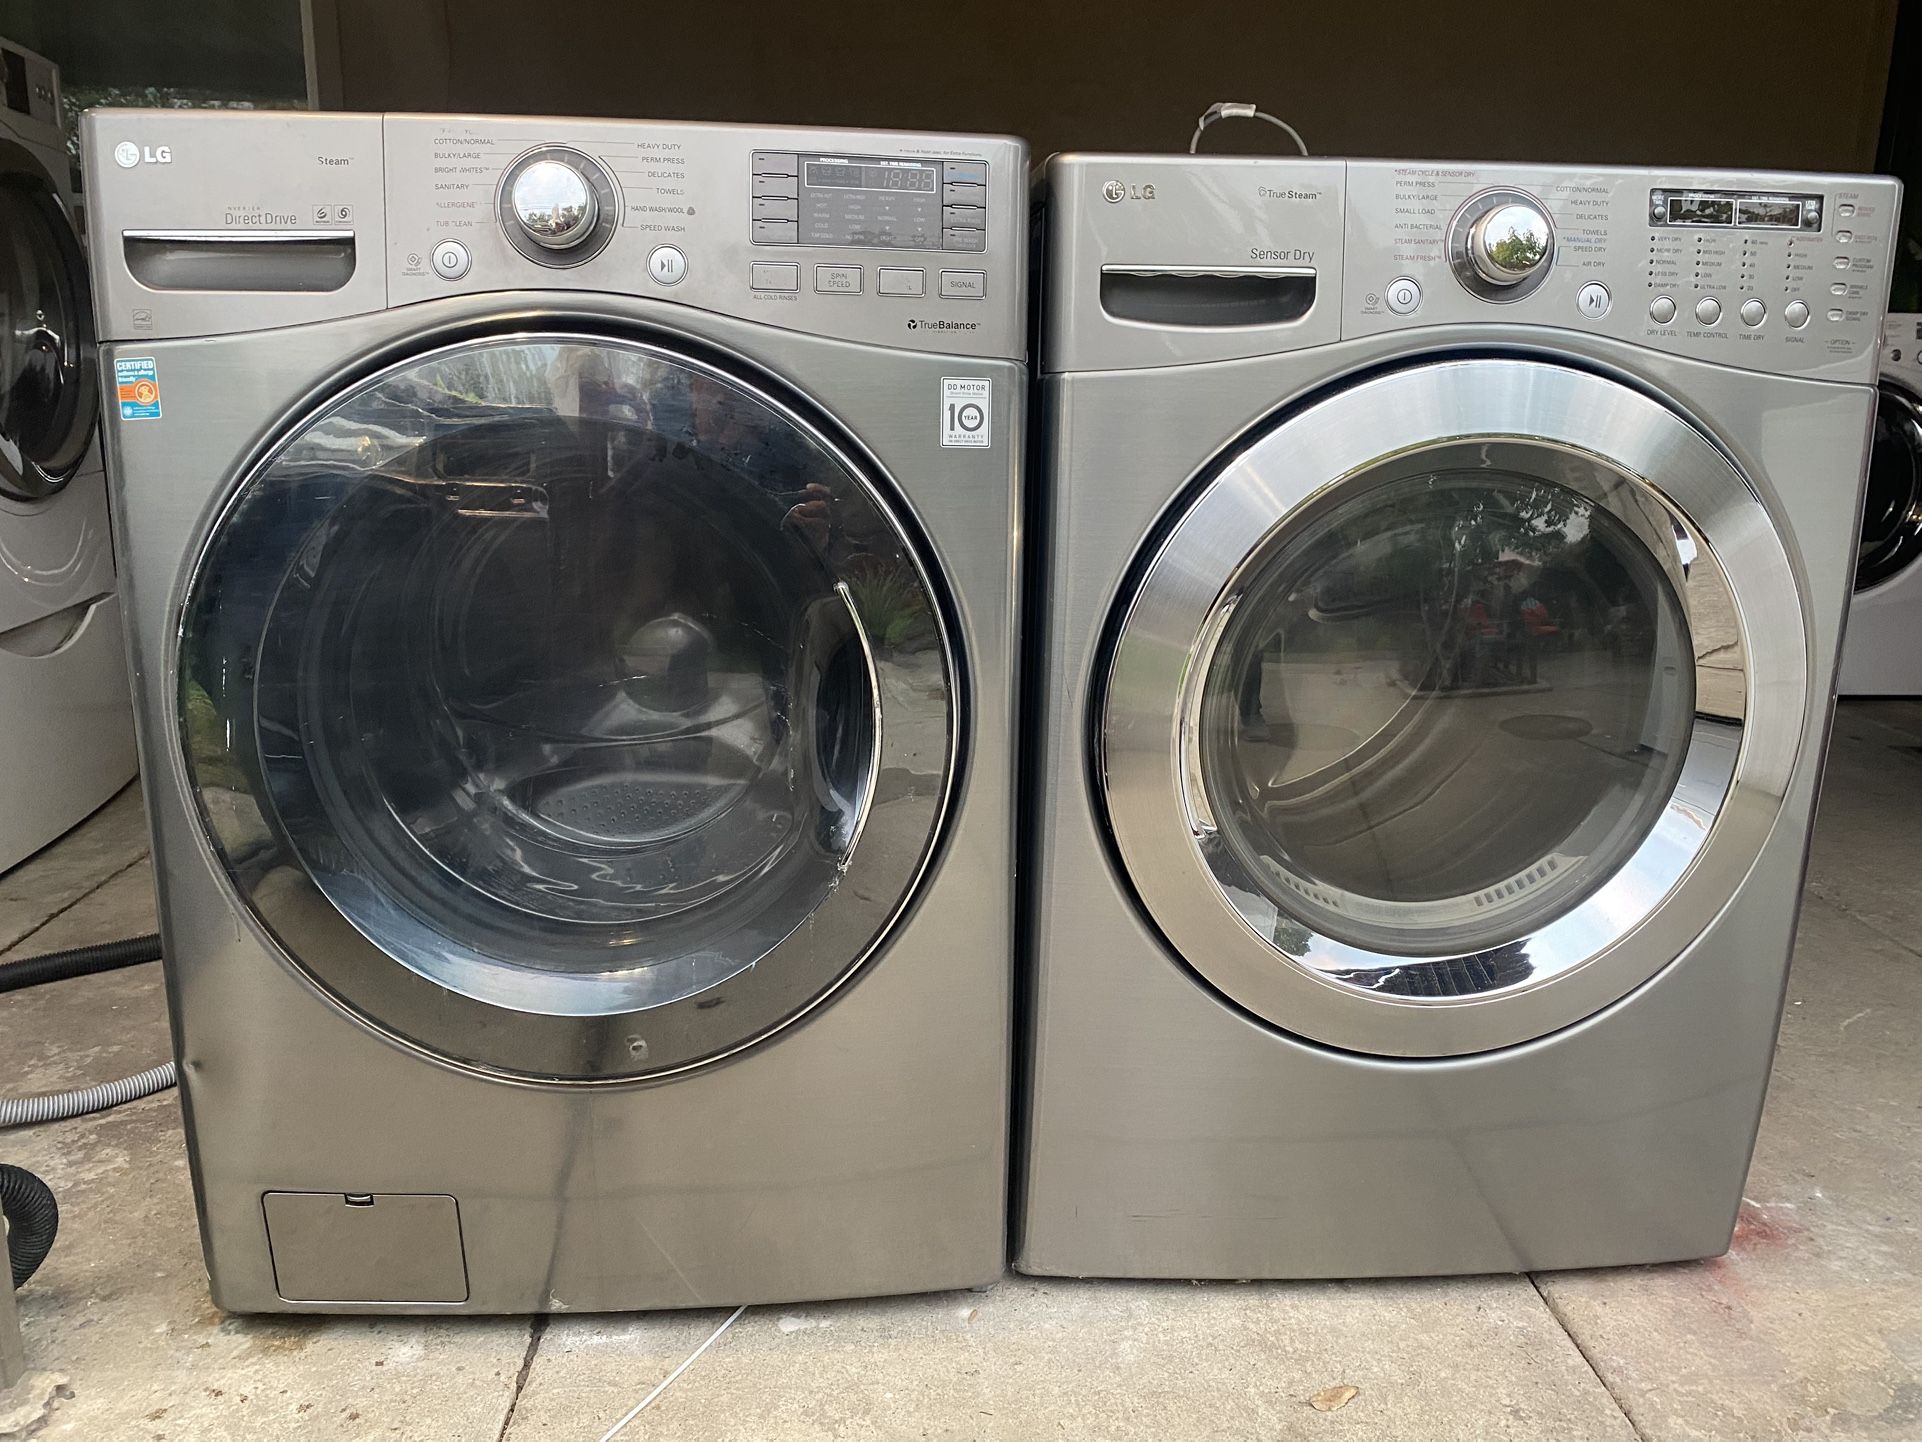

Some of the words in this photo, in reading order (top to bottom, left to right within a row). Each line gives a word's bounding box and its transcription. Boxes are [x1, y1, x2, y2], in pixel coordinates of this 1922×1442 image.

[434, 138, 494, 146] COTTON/NORMAL
[637, 142, 660, 150] HEAVY
[662, 143, 681, 151] DUTY
[144, 146, 172, 164] LG
[434, 152, 482, 160] BULKY/LARGE
[317, 156, 349, 166] Steam
[663, 157, 685, 165] PRESS
[434, 166, 458, 174] BRIGHT
[647, 170, 685, 179] DELICATES
[656, 187, 685, 196] TOWELS
[1131, 184, 1156, 200] LG
[1556, 186, 1609, 194] COTTON/NORMAL
[648, 205, 685, 214] WASH/WOOL
[225, 212, 263, 225] Direct
[265, 212, 297, 225] Drive
[1576, 213, 1609, 221] DELICATES
[640, 223, 663, 232] SPEED
[664, 225, 686, 233] WASH
[1573, 245, 1593, 253] SPEED
[1250, 248, 1291, 261] Sensor
[1293, 248, 1315, 263] Dry
[828, 280, 851, 288] SPEED
[950, 281, 976, 289] SIGNAL
[1703, 332, 1729, 340] CONTROL
[117, 361, 154, 370] CERTIFIED
[948, 383, 958, 391] DD
[960, 384, 986, 392] MOTOR
[949, 403, 985, 432] 10
